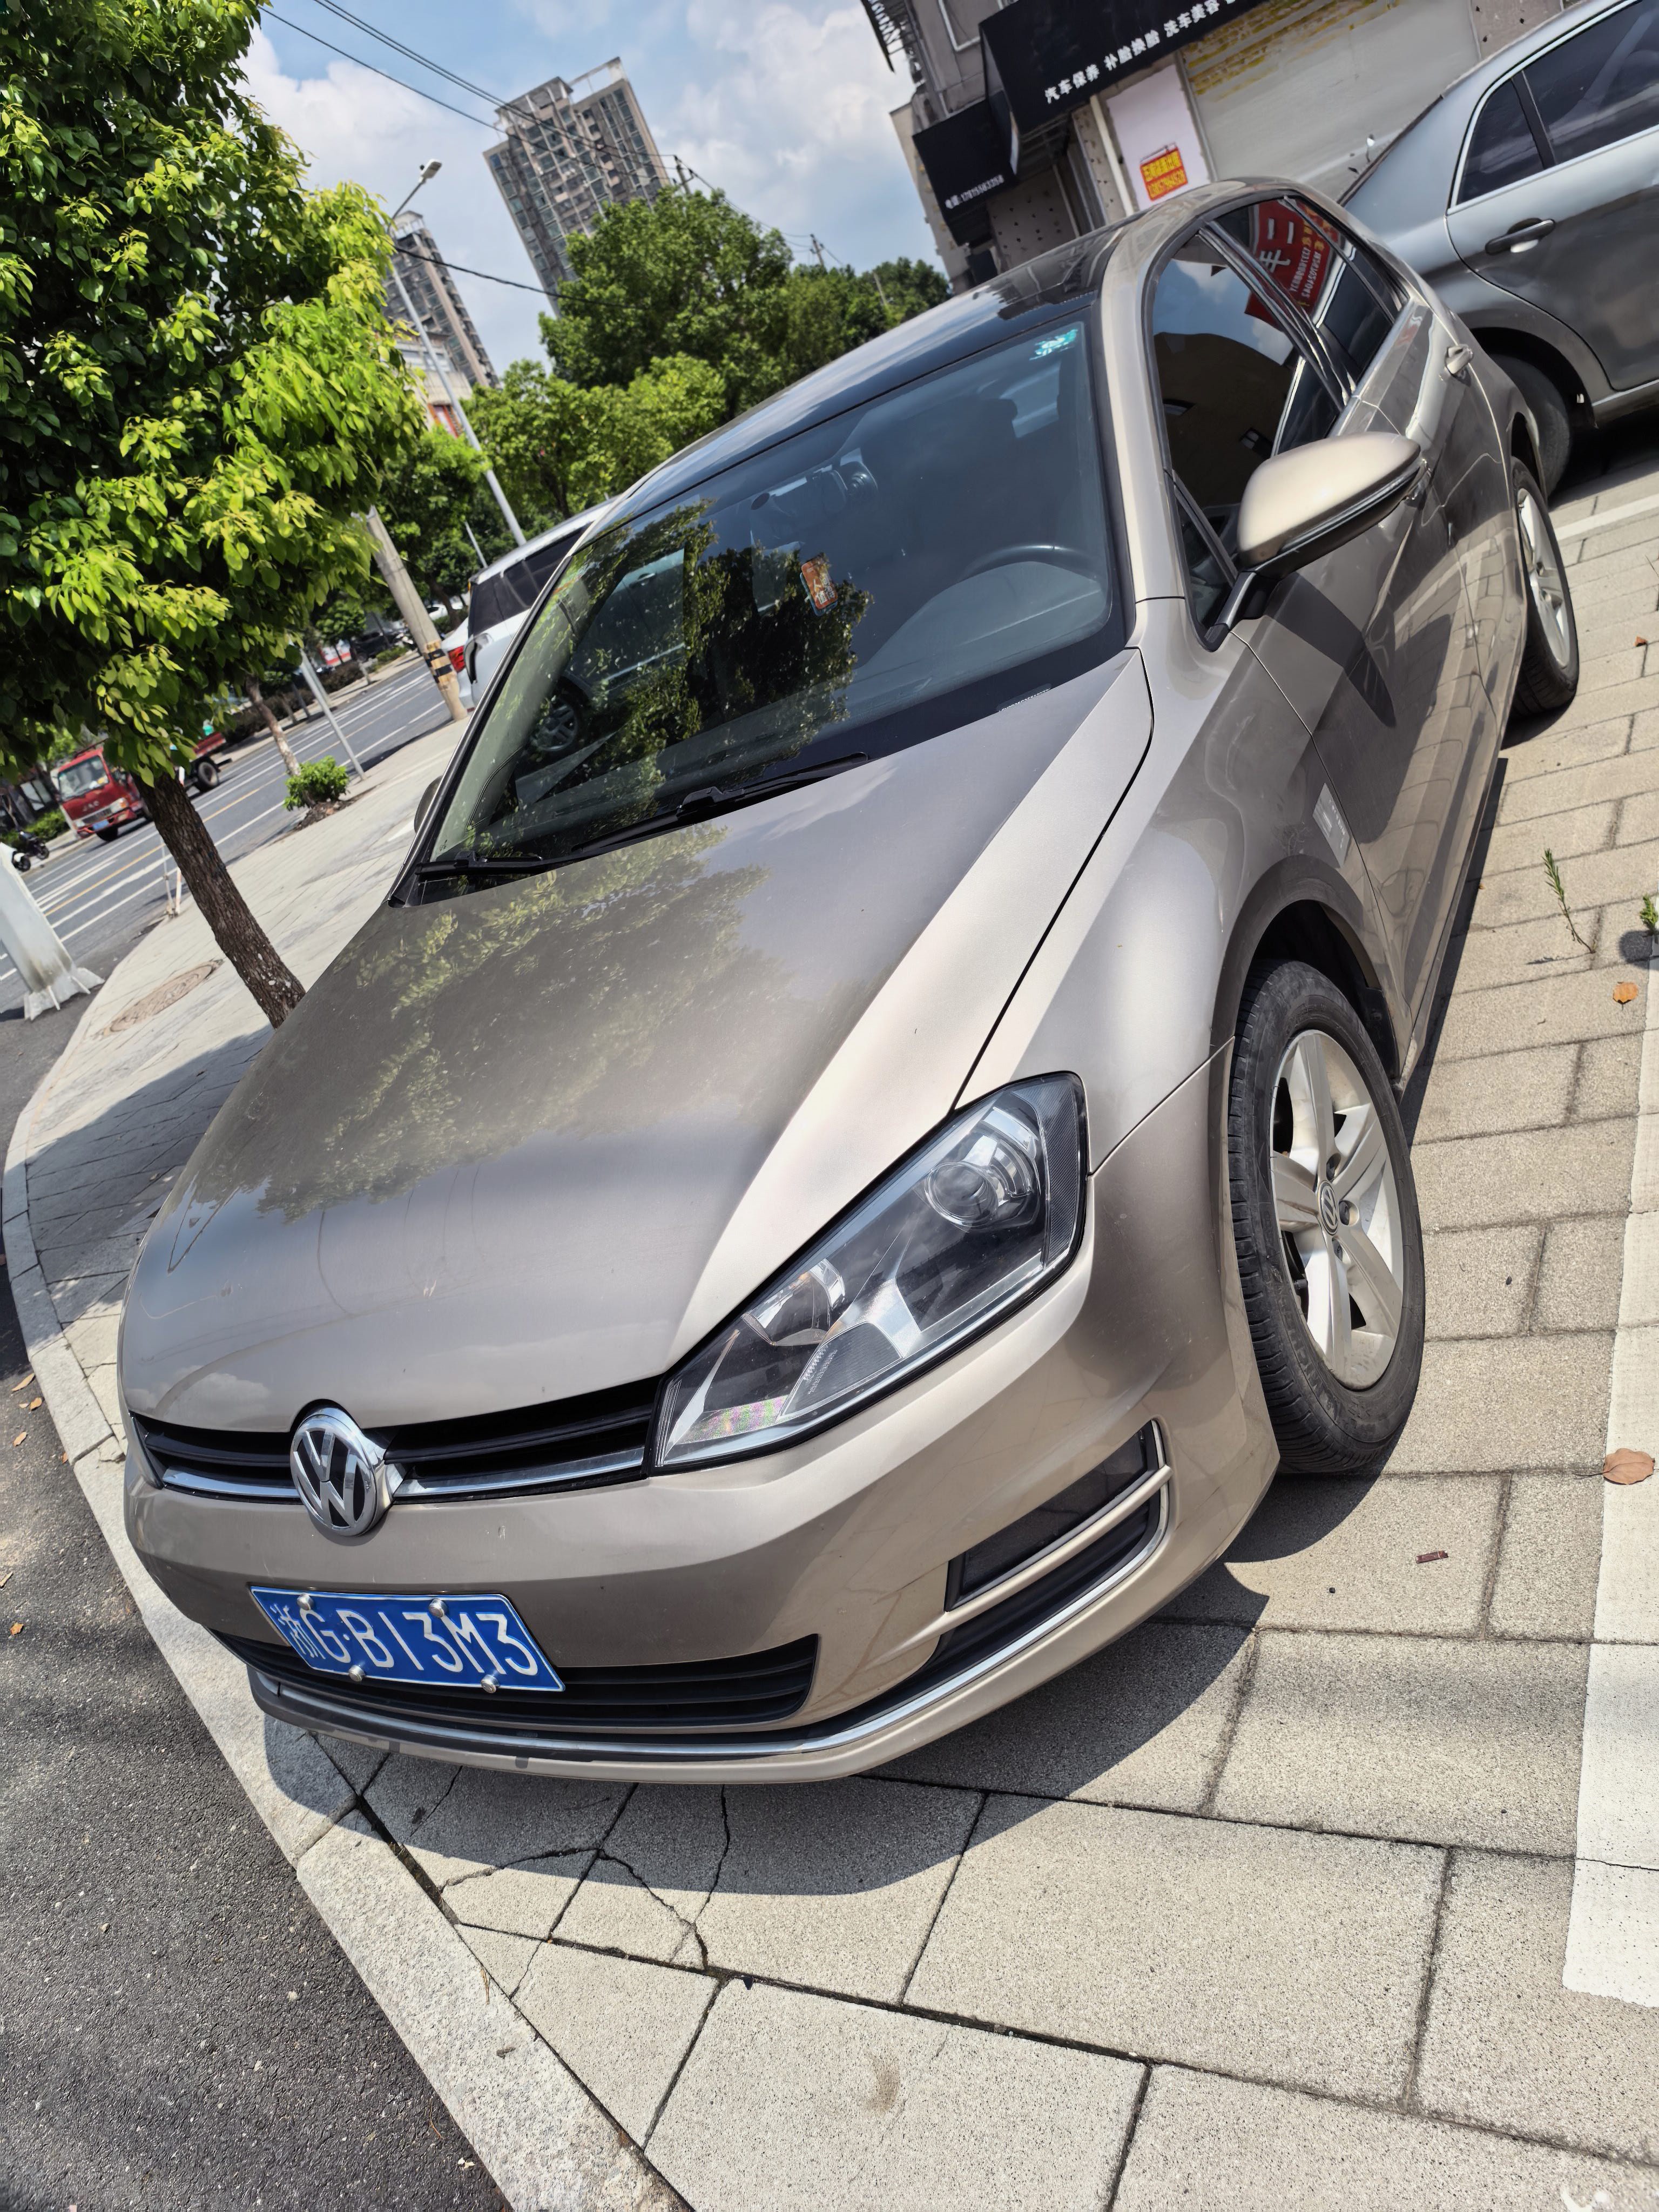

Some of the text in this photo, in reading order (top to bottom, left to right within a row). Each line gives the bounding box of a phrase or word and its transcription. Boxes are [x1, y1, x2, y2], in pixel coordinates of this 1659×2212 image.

[1044, 0, 1220, 104] 汽车保养 补胎换胎 洗车美容
